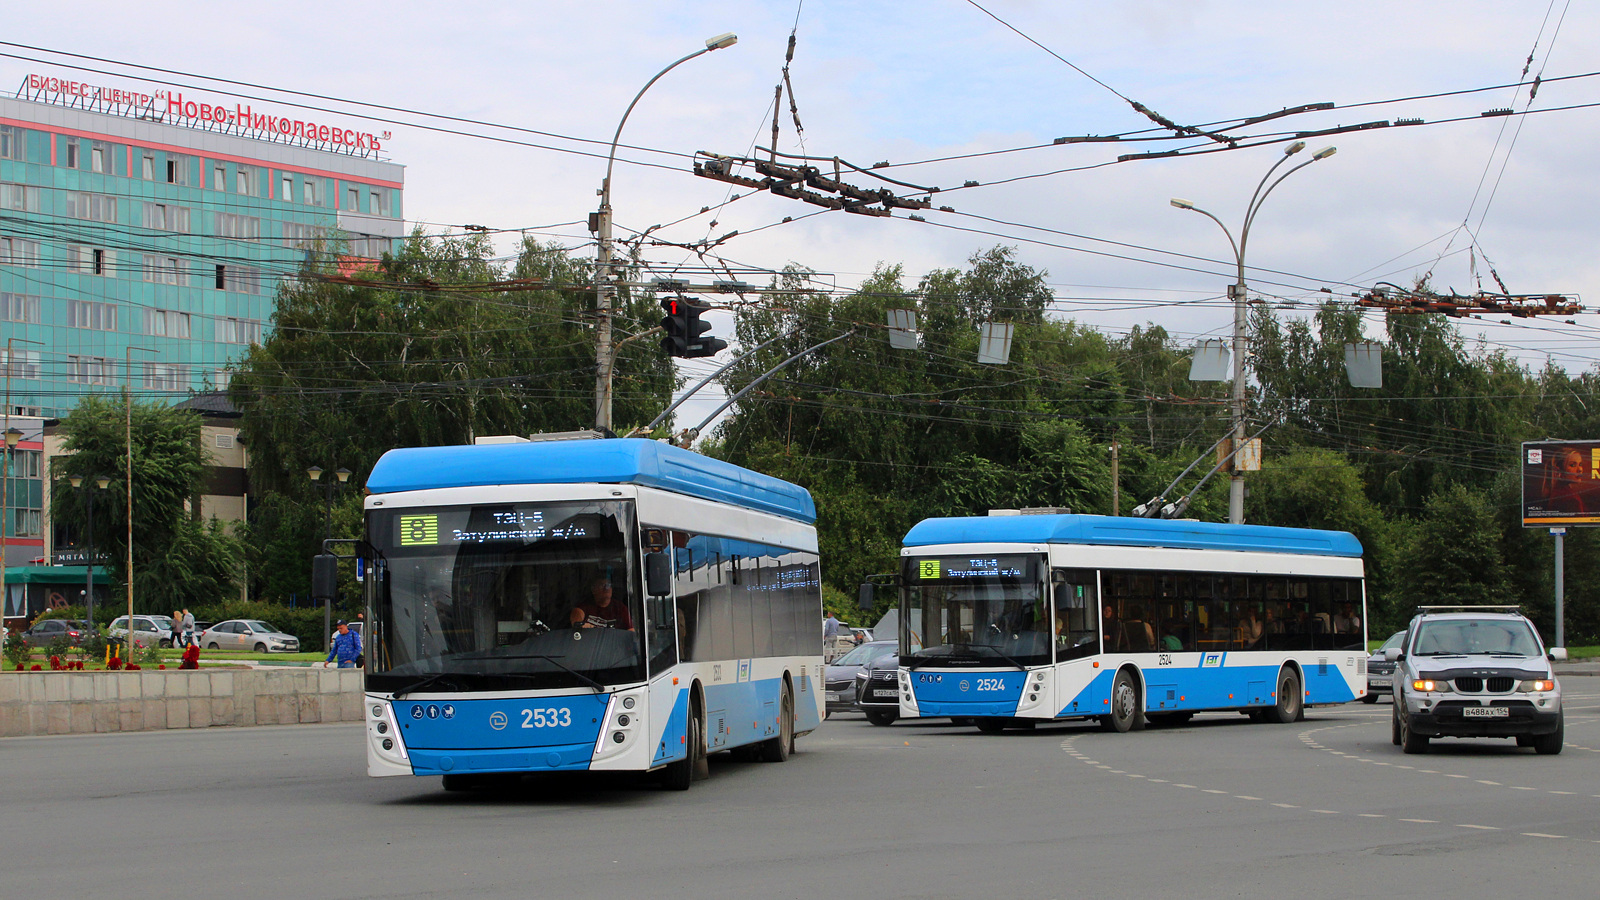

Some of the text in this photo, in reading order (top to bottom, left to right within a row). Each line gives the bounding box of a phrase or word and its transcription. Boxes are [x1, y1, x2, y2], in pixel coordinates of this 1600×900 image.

[493, 511, 543, 526] ТЭЦ-5
[410, 518, 426, 541] 8
[452, 523, 586, 543] Затулинский ж/м
[1158, 654, 1172, 666] 2524
[976, 678, 1006, 691] 2524
[521, 707, 572, 729] 2533
